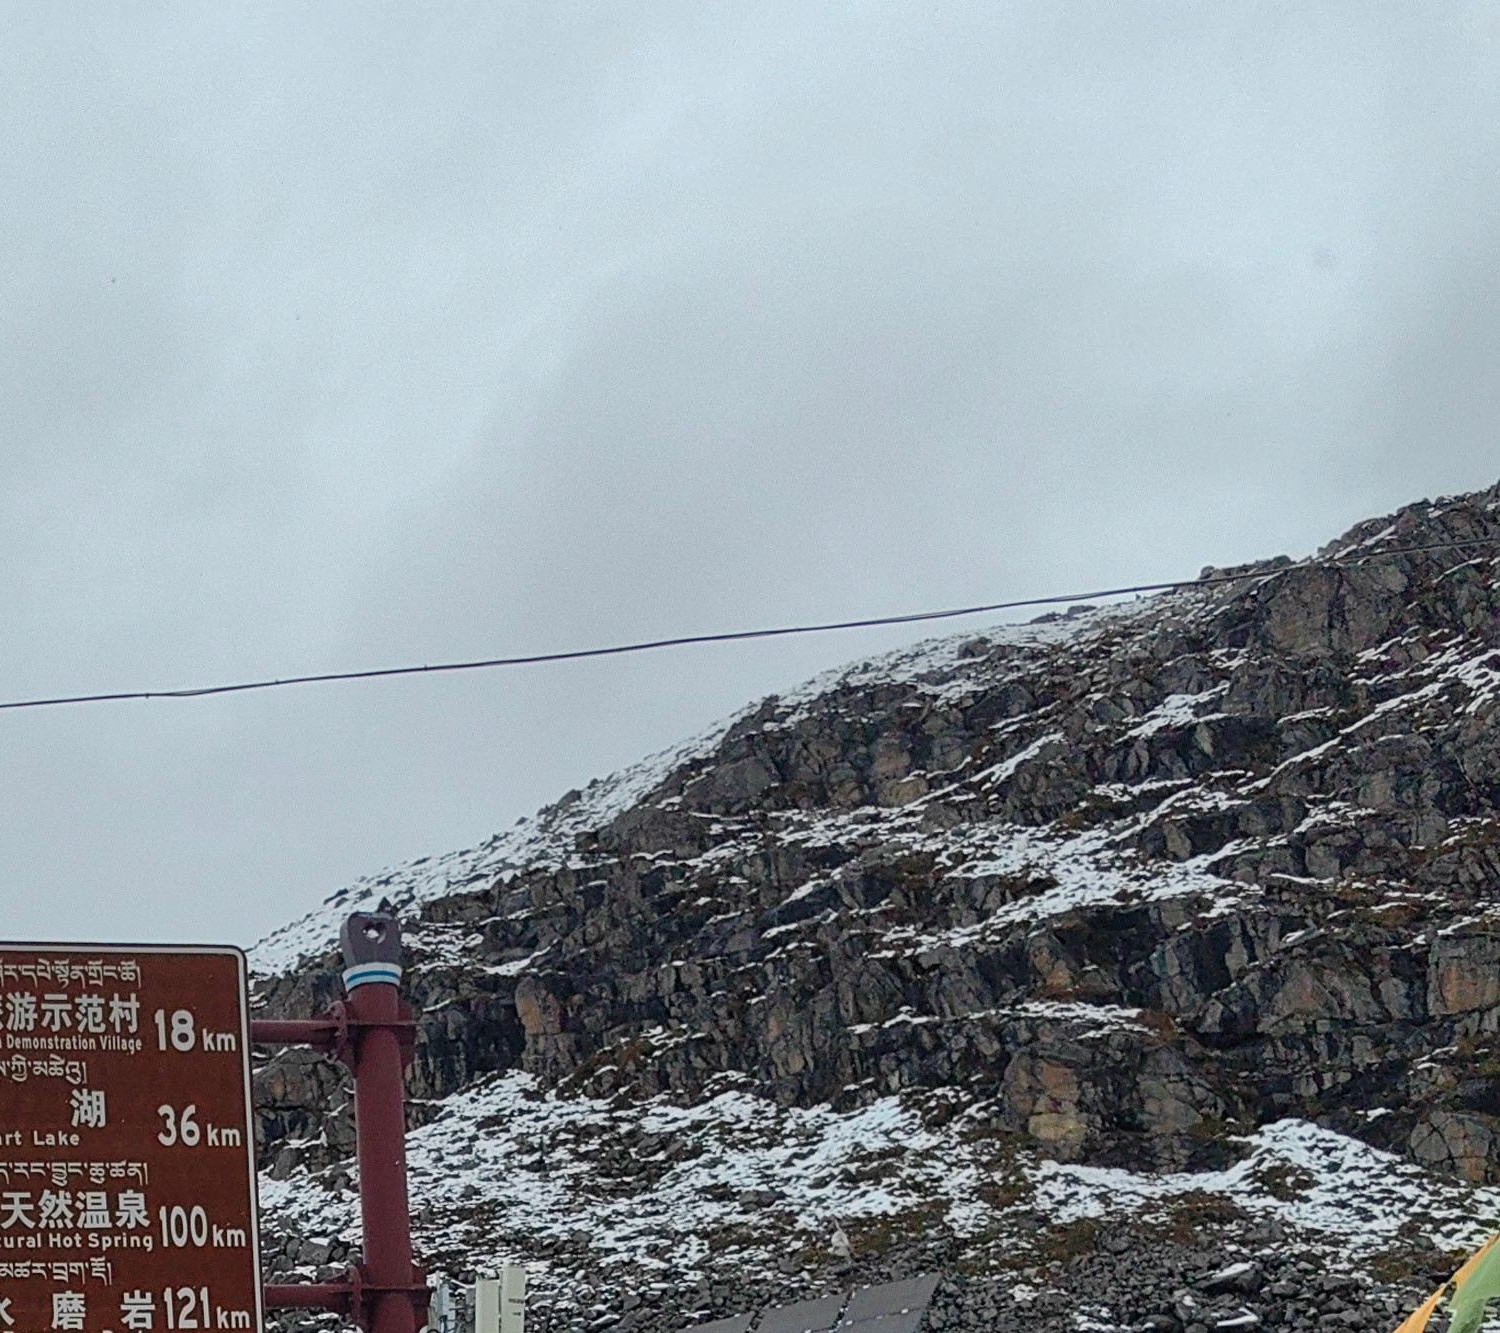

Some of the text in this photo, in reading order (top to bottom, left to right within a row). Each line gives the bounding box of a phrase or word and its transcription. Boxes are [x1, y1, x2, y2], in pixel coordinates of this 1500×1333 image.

[6, 1033, 96, 1050] Demonstration
[99, 1035, 142, 1055] Village
[33, 1130, 80, 1146] Lake
[48, 1232, 82, 1248] Hot
[88, 1232, 153, 1252] Spring
